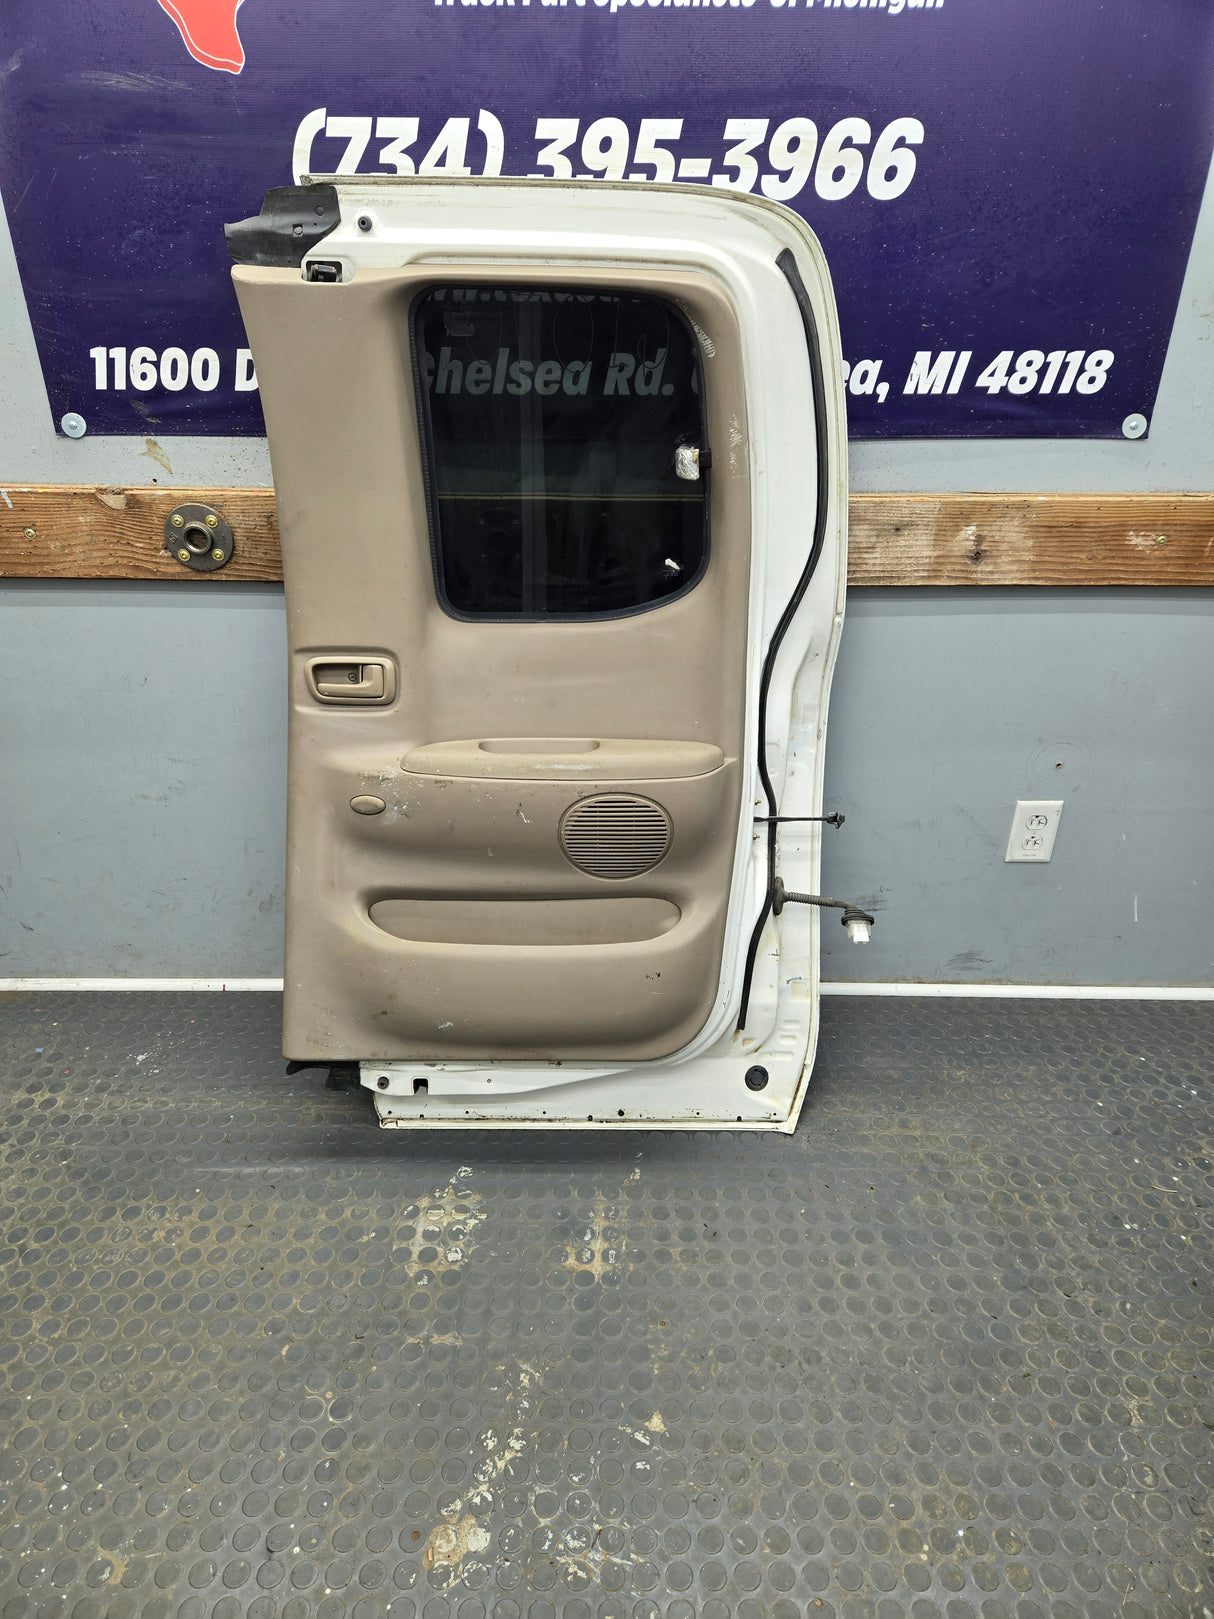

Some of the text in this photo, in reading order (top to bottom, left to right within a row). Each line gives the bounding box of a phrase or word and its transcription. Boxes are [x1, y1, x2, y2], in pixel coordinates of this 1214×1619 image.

[292, 107, 925, 201] (734) 395-3966
[89, 346, 221, 392] 11600
[602, 348, 675, 396] Rd.
[902, 350, 973, 395] MI
[975, 349, 1115, 395] 48118
